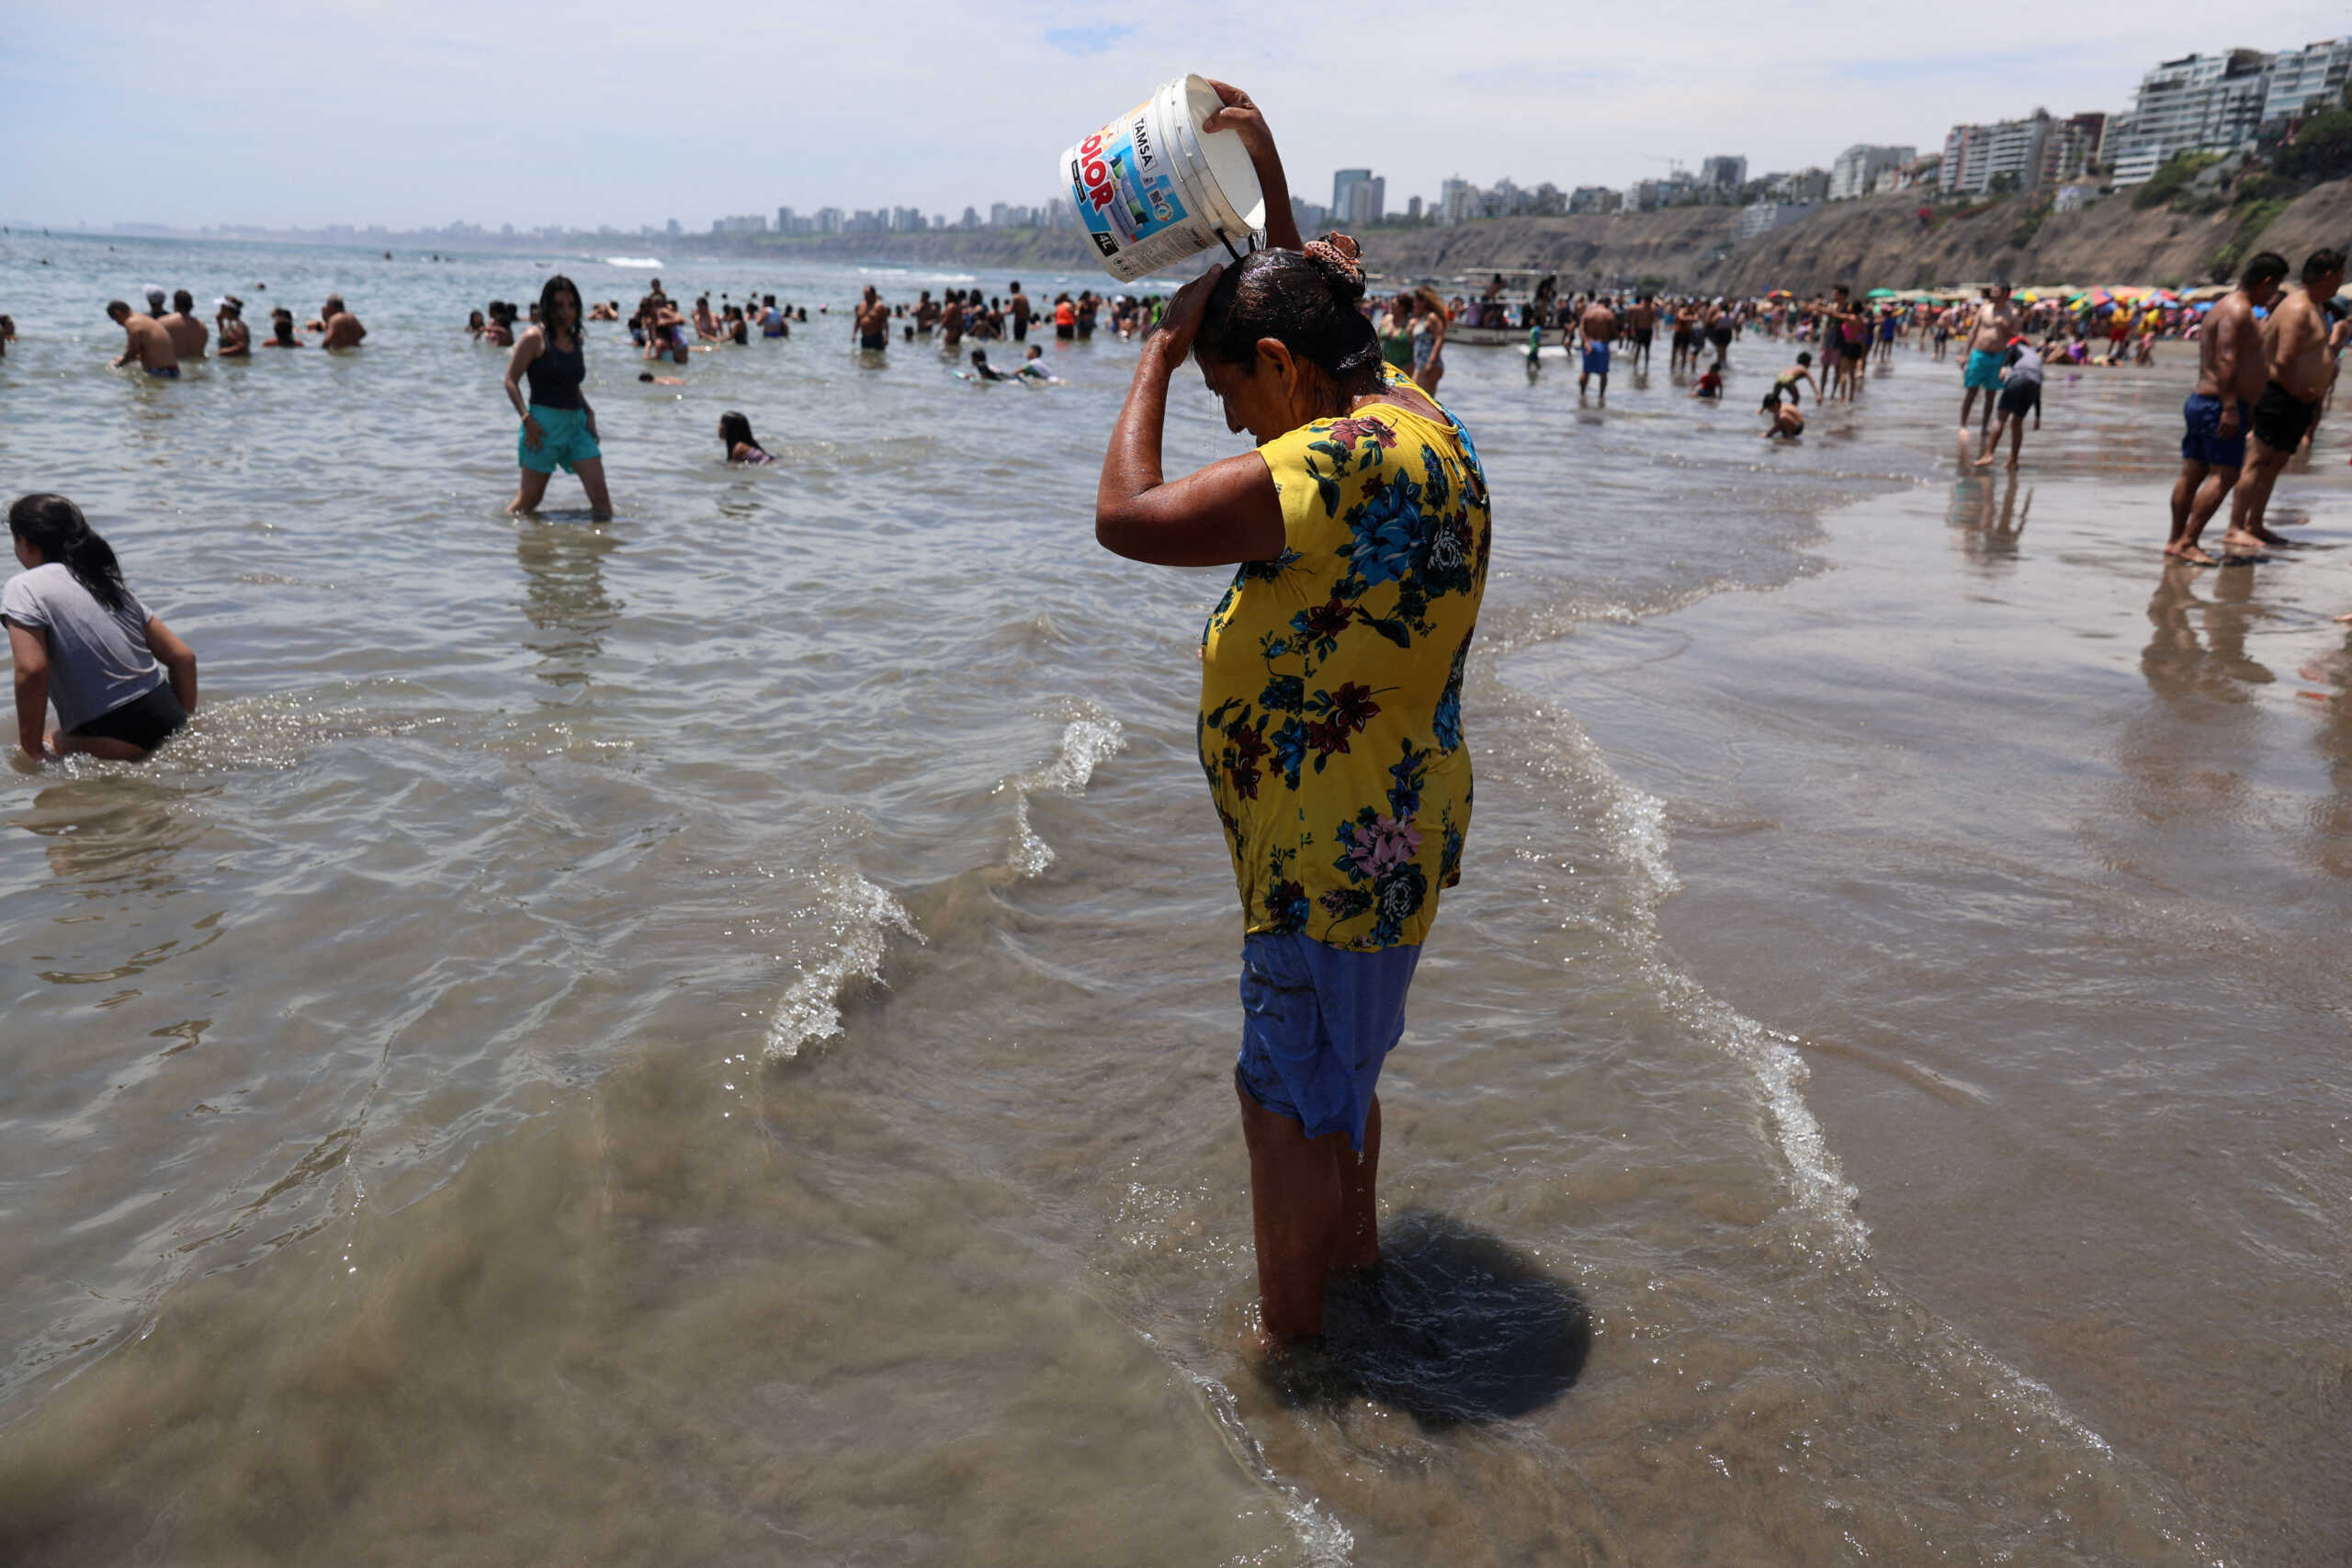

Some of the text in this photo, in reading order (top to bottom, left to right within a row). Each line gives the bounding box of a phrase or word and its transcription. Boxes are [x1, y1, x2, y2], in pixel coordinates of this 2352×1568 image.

[1135, 118, 1153, 167] TAMSA
[1080, 135, 1114, 213] OLOR
[1099, 234, 1112, 250] 4L
